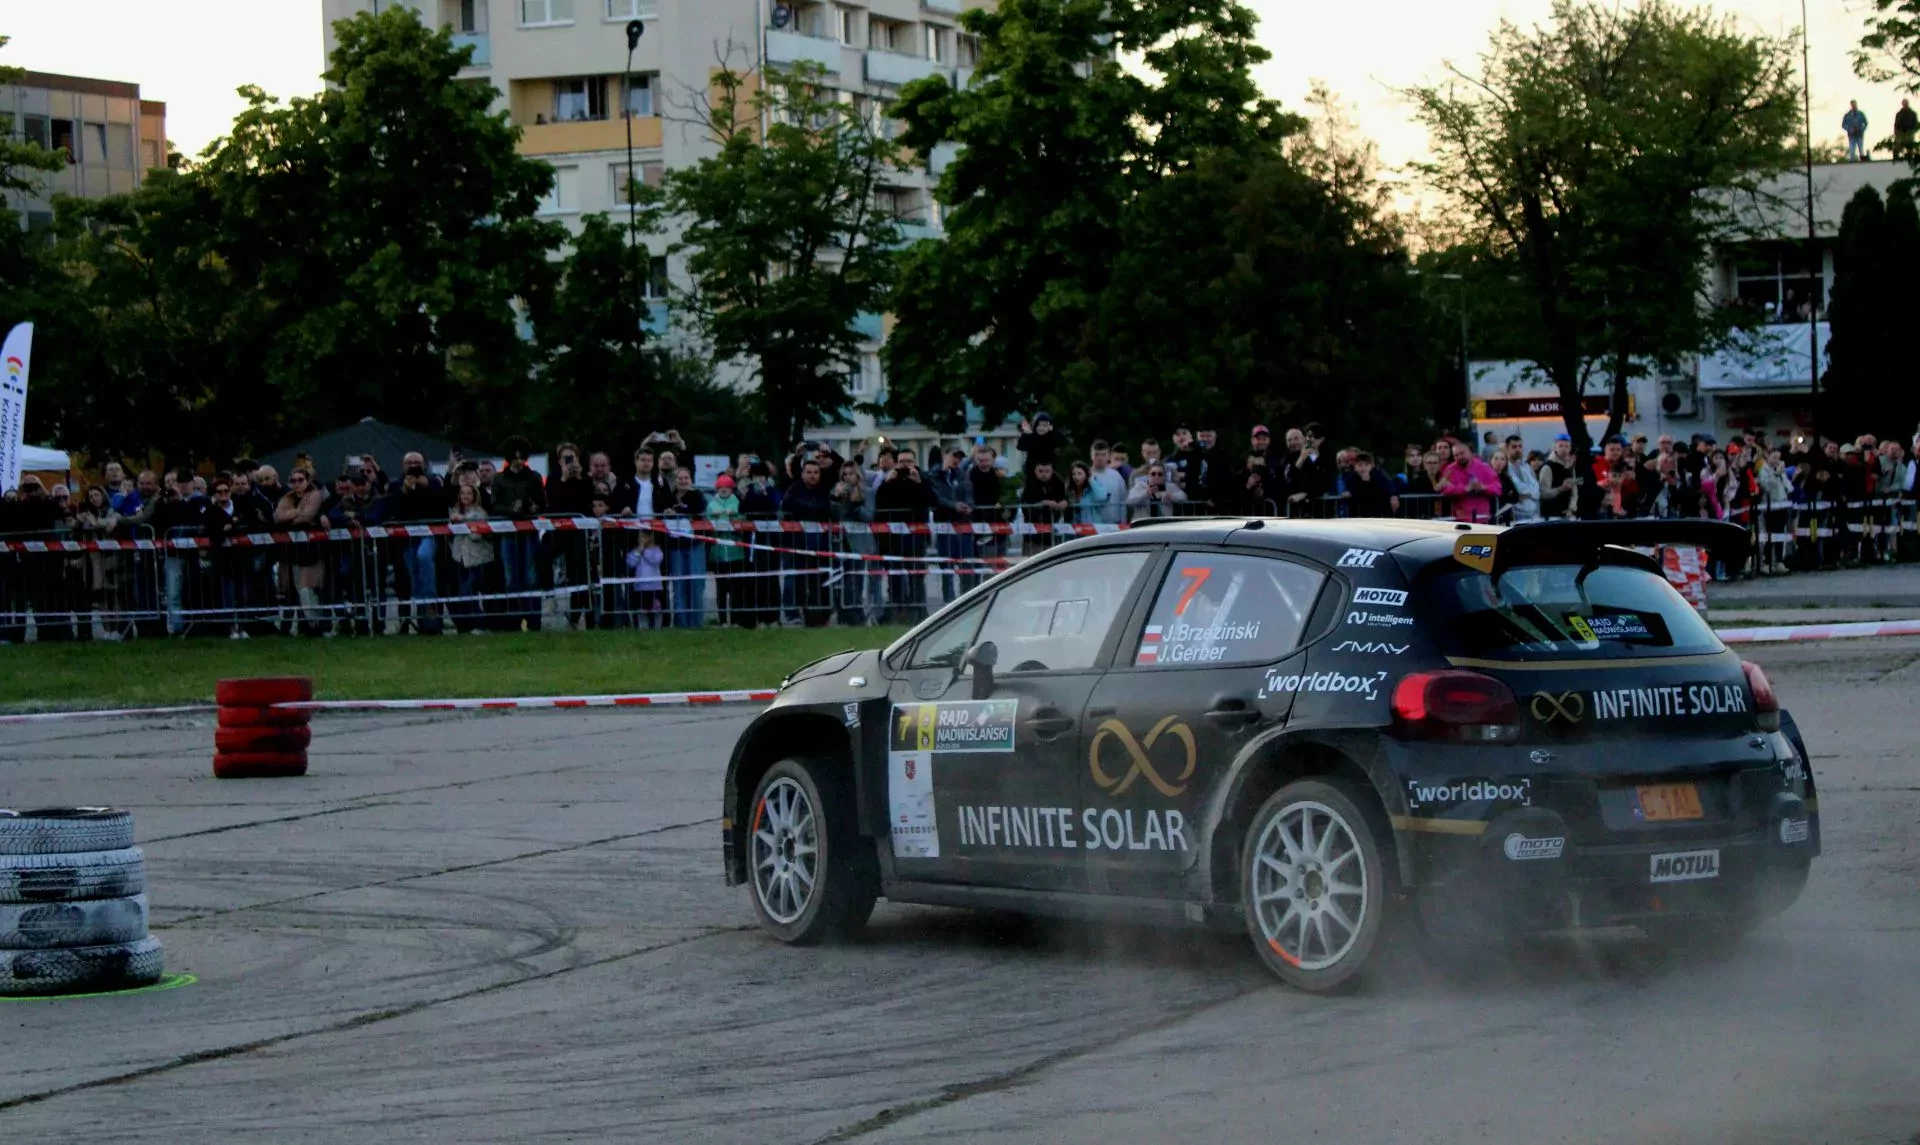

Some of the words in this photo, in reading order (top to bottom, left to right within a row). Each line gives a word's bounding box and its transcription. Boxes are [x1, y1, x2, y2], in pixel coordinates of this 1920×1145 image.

[1528, 403, 1559, 412] ALIOR
[1174, 567, 1212, 616] 7
[1356, 589, 1403, 604] MOTUL
[1369, 613, 1414, 625] intelligent
[1588, 618, 1611, 627] RAJD
[1163, 621, 1260, 642] J.Brzeziński
[1156, 645, 1227, 662] J.Gerber
[1267, 671, 1377, 693] worldbox
[1593, 687, 1686, 719] INFINITE
[1689, 685, 1747, 714] SOLAR
[939, 710, 969, 726] RAJD
[899, 716, 912, 741] 7
[937, 725, 1009, 741] NADWIŚLAŃSKI
[1416, 782, 1524, 802] worldbox
[958, 805, 1077, 848] INFINITE
[1082, 807, 1188, 851] SOLAR
[1519, 838, 1564, 849] MOTO
[1653, 855, 1716, 877] MOTUL
